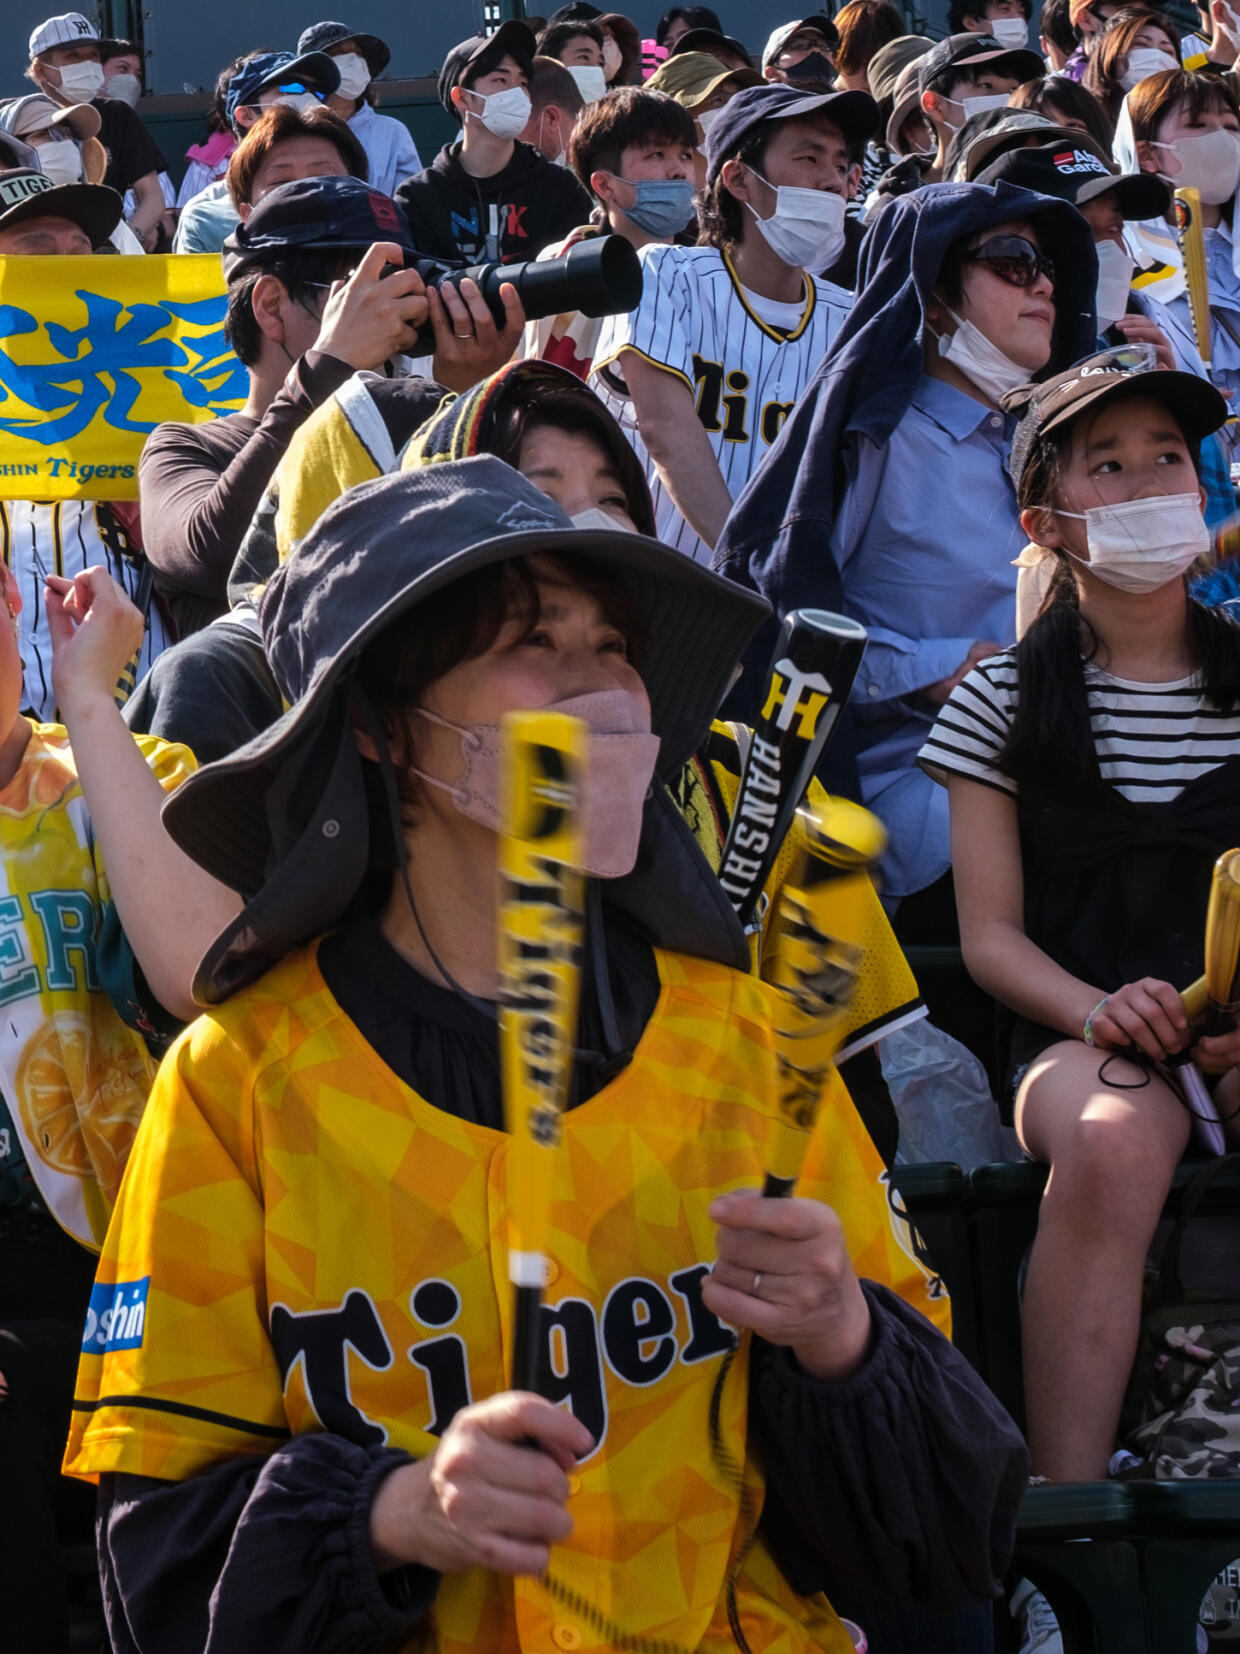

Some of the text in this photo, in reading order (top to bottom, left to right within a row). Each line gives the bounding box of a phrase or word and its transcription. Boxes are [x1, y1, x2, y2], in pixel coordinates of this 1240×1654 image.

[1073, 149, 1099, 163] Ab
[3, 178, 55, 198] TIGE
[47, 456, 135, 484] Tigers
[719, 732, 781, 911] HANSHI
[269, 1262, 738, 1462] Tiger
